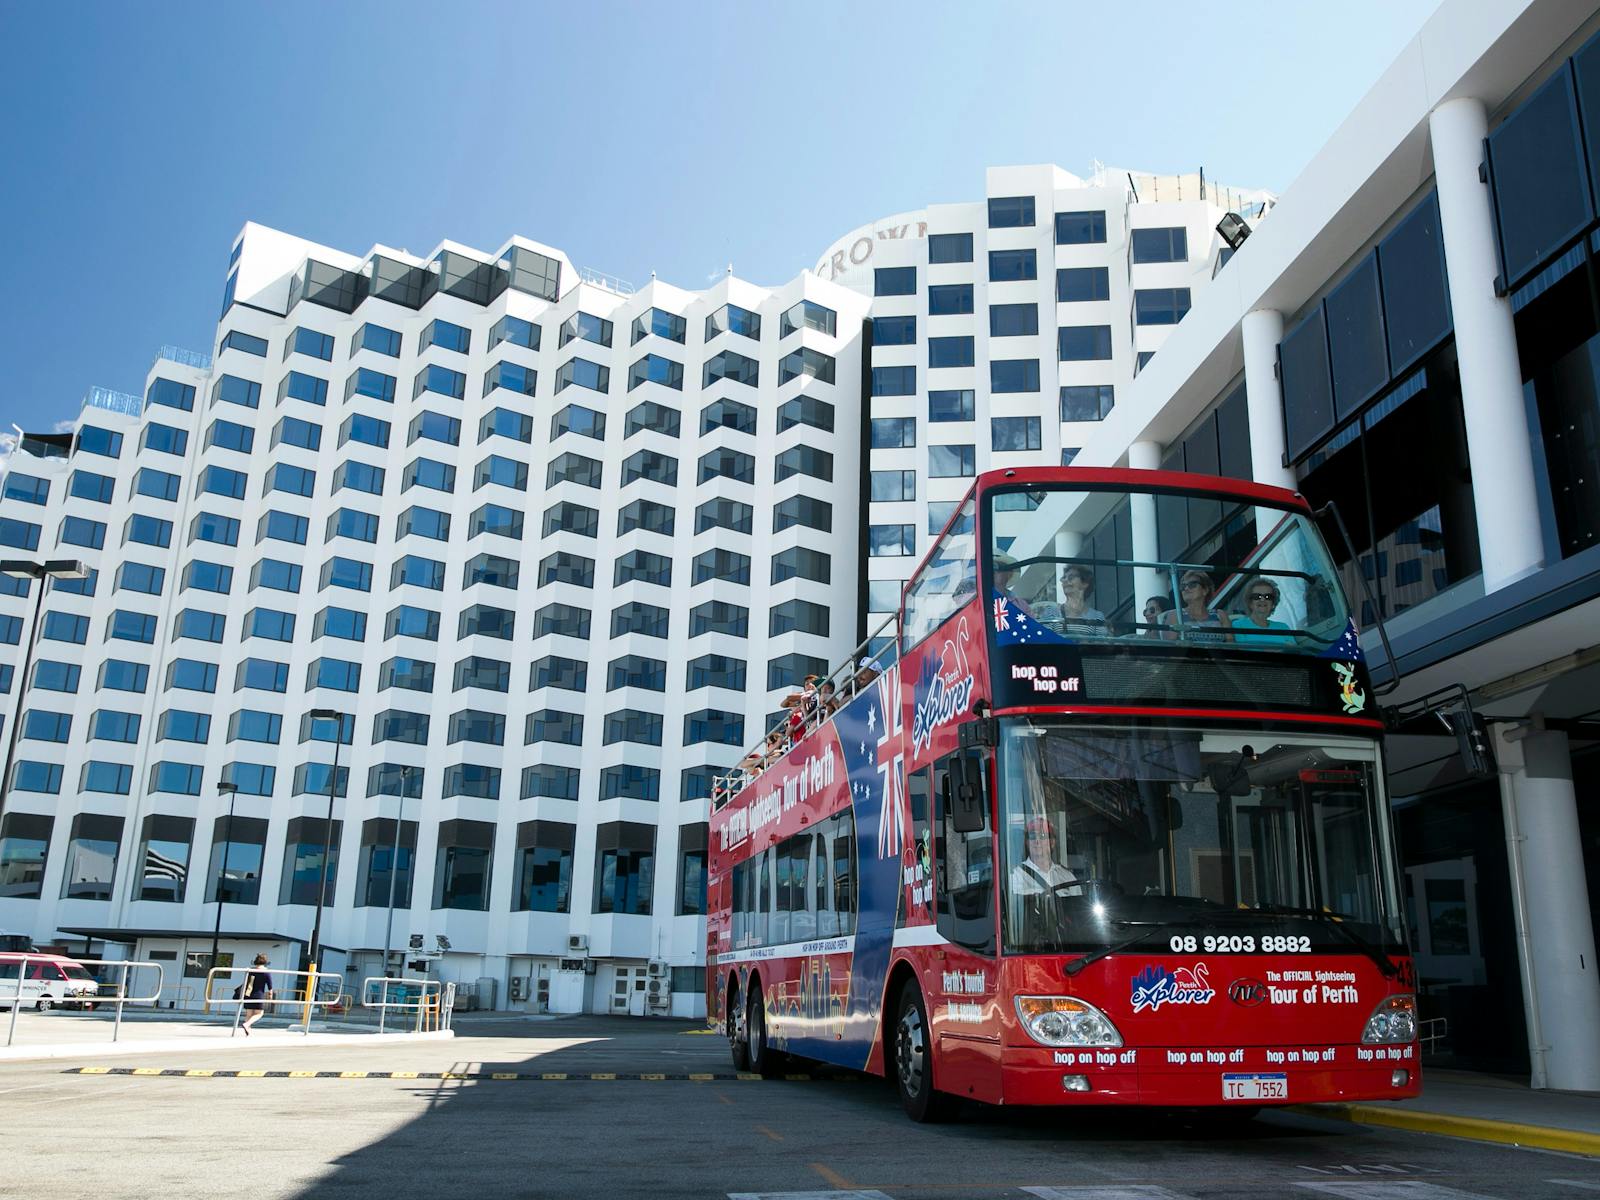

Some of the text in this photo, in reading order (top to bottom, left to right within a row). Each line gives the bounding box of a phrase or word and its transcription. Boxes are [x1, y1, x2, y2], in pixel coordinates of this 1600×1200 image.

[1012, 665, 1058, 680] hop on
[1033, 678, 1079, 693] hop off
[783, 775, 798, 812] Tour
[800, 757, 809, 802] of
[811, 743, 834, 795] Perth
[904, 864, 923, 887] hop on
[913, 878, 933, 907] hop off
[1170, 935, 1312, 953] 08 9203 8882
[1179, 981, 1197, 989] Perth
[1266, 971, 1356, 983] The OFFICIAL Sightseeing
[1267, 984, 1358, 1004] Tour of Perth
[1055, 1050, 1136, 1066] hop on hop off
[1167, 1049, 1244, 1065] hop on hop off
[1266, 1048, 1336, 1064] hop on hop off
[1357, 1046, 1413, 1062] hop on hop off
[1228, 1083, 1283, 1098] TC 7552
